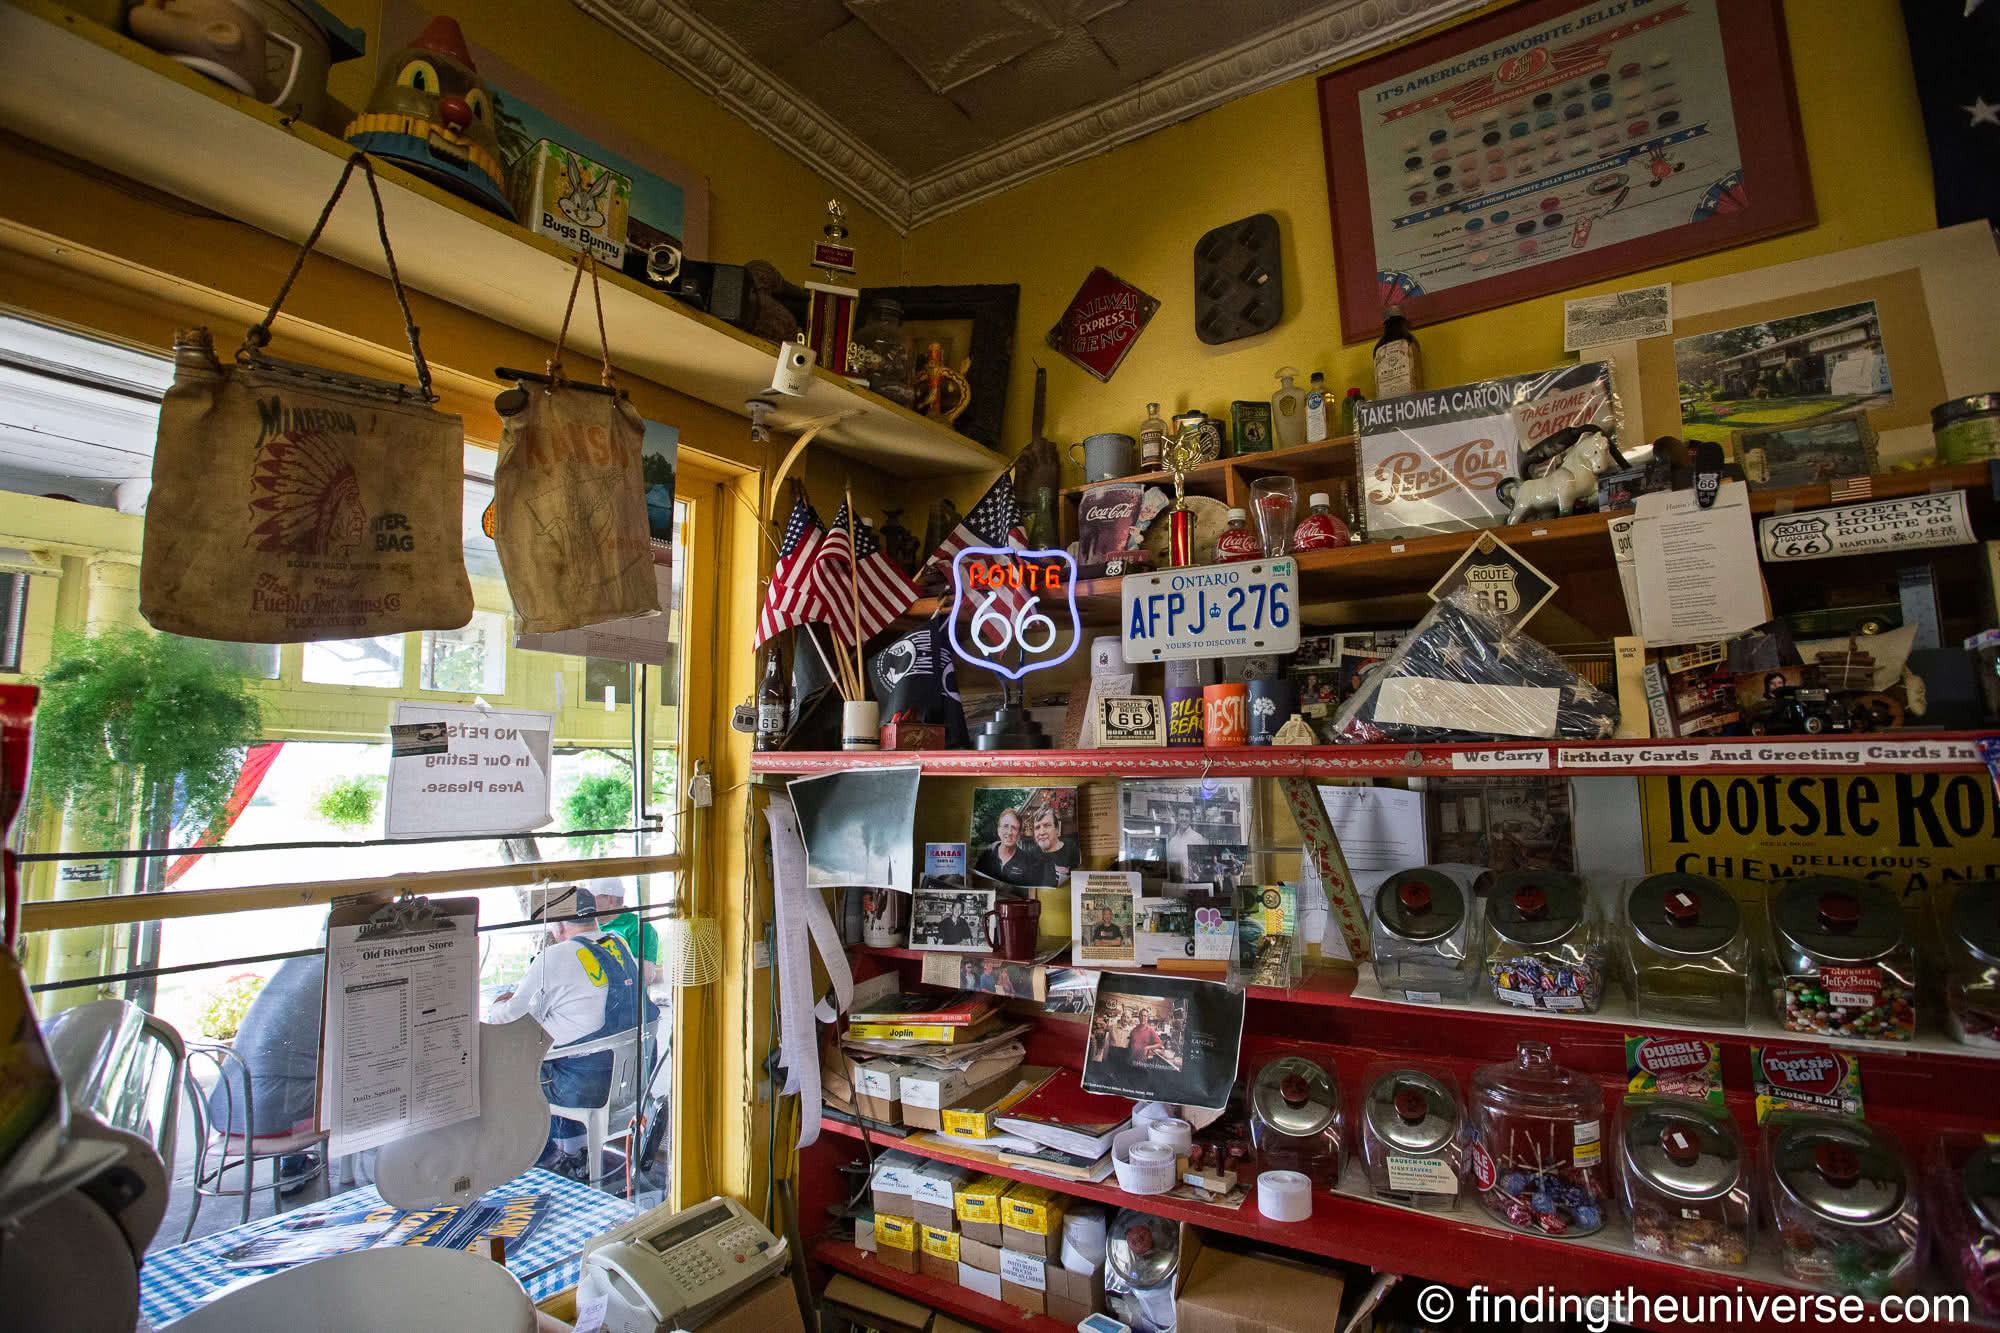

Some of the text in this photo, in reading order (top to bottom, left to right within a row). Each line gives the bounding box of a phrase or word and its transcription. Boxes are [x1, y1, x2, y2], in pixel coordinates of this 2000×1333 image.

[1375, 1, 1628, 103] IT'S AMERICA'S FAVORITE JELLY
[543, 212, 620, 259] Bugs Bunny
[1079, 310, 1125, 336] EXPRESS
[1360, 406, 1393, 428] TAKE
[1394, 400, 1439, 422] HOME
[1439, 398, 1450, 414] A
[1451, 384, 1511, 412] CARTON
[1520, 404, 1551, 422] TAKE
[1551, 395, 1584, 413] HOME
[1699, 479, 1716, 489] 66
[1086, 502, 1133, 522] Coca-Cola
[1834, 506, 1953, 529] KICKS ON
[1846, 503, 1904, 519] GET
[1910, 497, 1952, 509] MY
[1777, 521, 1820, 536] ROUTE
[1837, 515, 1953, 537] ROUTE 66
[375, 534, 415, 552] BAG
[1785, 540, 1822, 556] 66
[1839, 537, 1888, 549] HAKUBA
[968, 563, 1062, 590] ROUTE
[1107, 566, 1120, 574] 66
[1473, 569, 1510, 580] ROUTE
[1171, 572, 1240, 591] ONTARIO
[1476, 589, 1508, 612] 66
[1129, 582, 1288, 641] AFPJ 276
[970, 591, 1057, 656] 66
[1165, 642, 1191, 651] YOURS
[1206, 637, 1248, 648] DISCOVER
[762, 718, 779, 729] 66
[1118, 714, 1143, 726] 66
[1652, 700, 1671, 737] FOOD
[1463, 750, 1544, 766] We Carry
[1638, 749, 1700, 763] Cards
[1709, 747, 1754, 762] And
[1758, 746, 1861, 765] Greeting
[1867, 744, 1942, 760] Cards
[1948, 745, 1975, 760] In
[1667, 774, 1880, 844] Tootsie
[928, 850, 962, 858] KANSAS
[1792, 853, 1933, 869] DELICIOUS
[362, 940, 454, 961] Old Riverton Store
[1850, 976, 1882, 990] Beans
[889, 1027, 914, 1039] Joplin
[1642, 1040, 1703, 1059] DUBBLE
[1647, 1052, 1708, 1071] BUBBLE
[1765, 1055, 1834, 1072] Tootsie
[1785, 1068, 1825, 1083] Roll
[352, 1093, 371, 1104] Daily
[1773, 1087, 1839, 1108] Tootsie Roll
